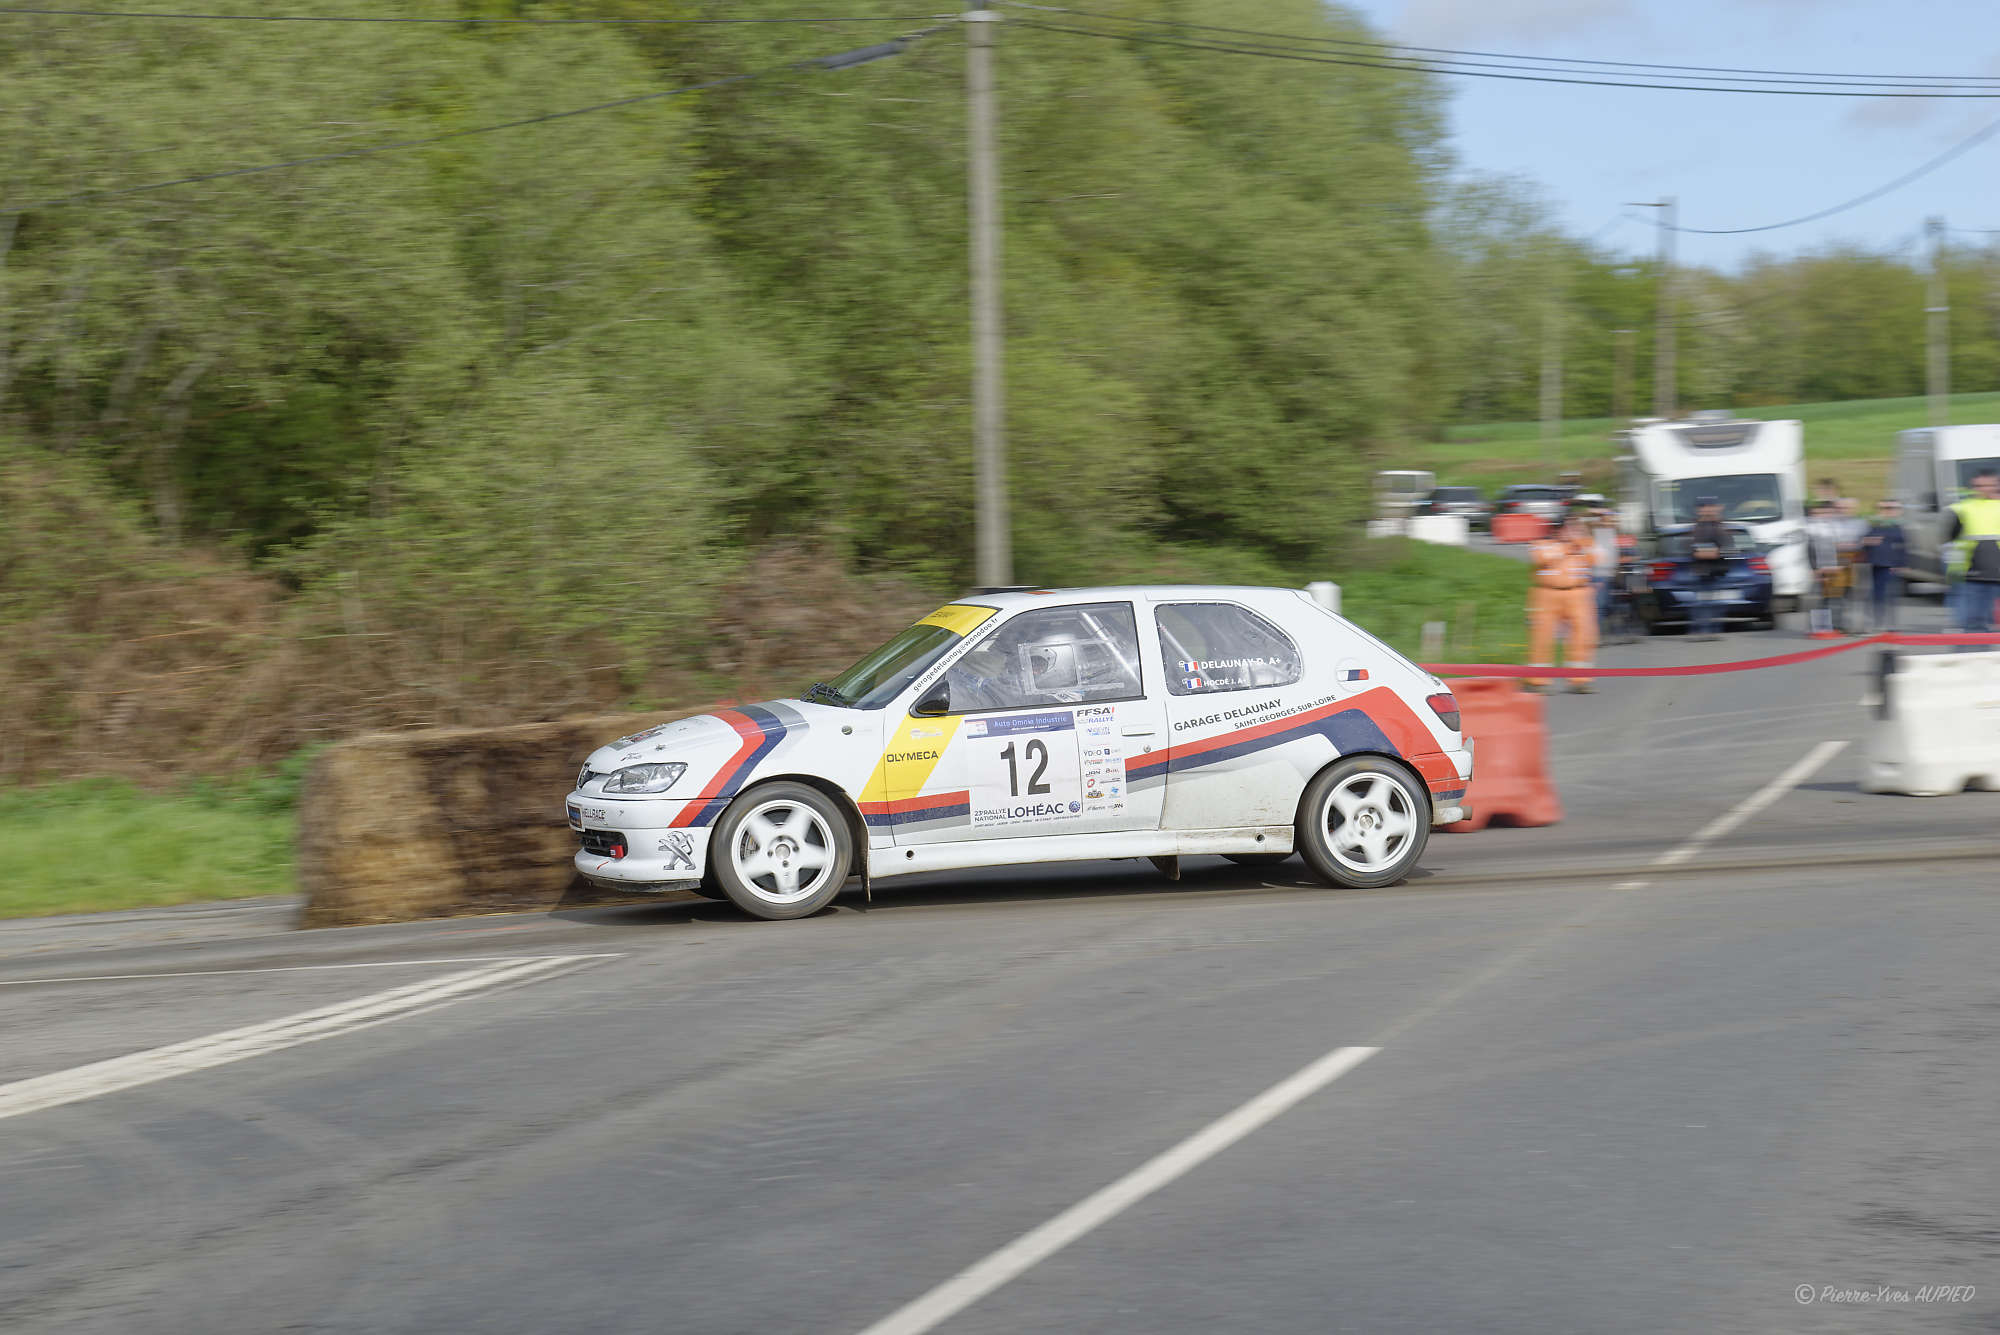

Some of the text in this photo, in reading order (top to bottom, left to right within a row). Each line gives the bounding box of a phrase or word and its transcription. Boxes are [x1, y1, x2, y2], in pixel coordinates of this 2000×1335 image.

[1201, 659, 1253, 670] DELAUNAY
[1077, 707, 1111, 718] FFSA
[1174, 699, 1282, 732] GARAGE DELAUNAY
[1234, 694, 1337, 730] SAINT-GEORGES-SUR-LOIRE
[887, 751, 939, 763] OLYMECA
[1000, 739, 1051, 796] 12
[974, 814, 1007, 822] NATIONAL
[1007, 803, 1064, 819] LOHÉAC
